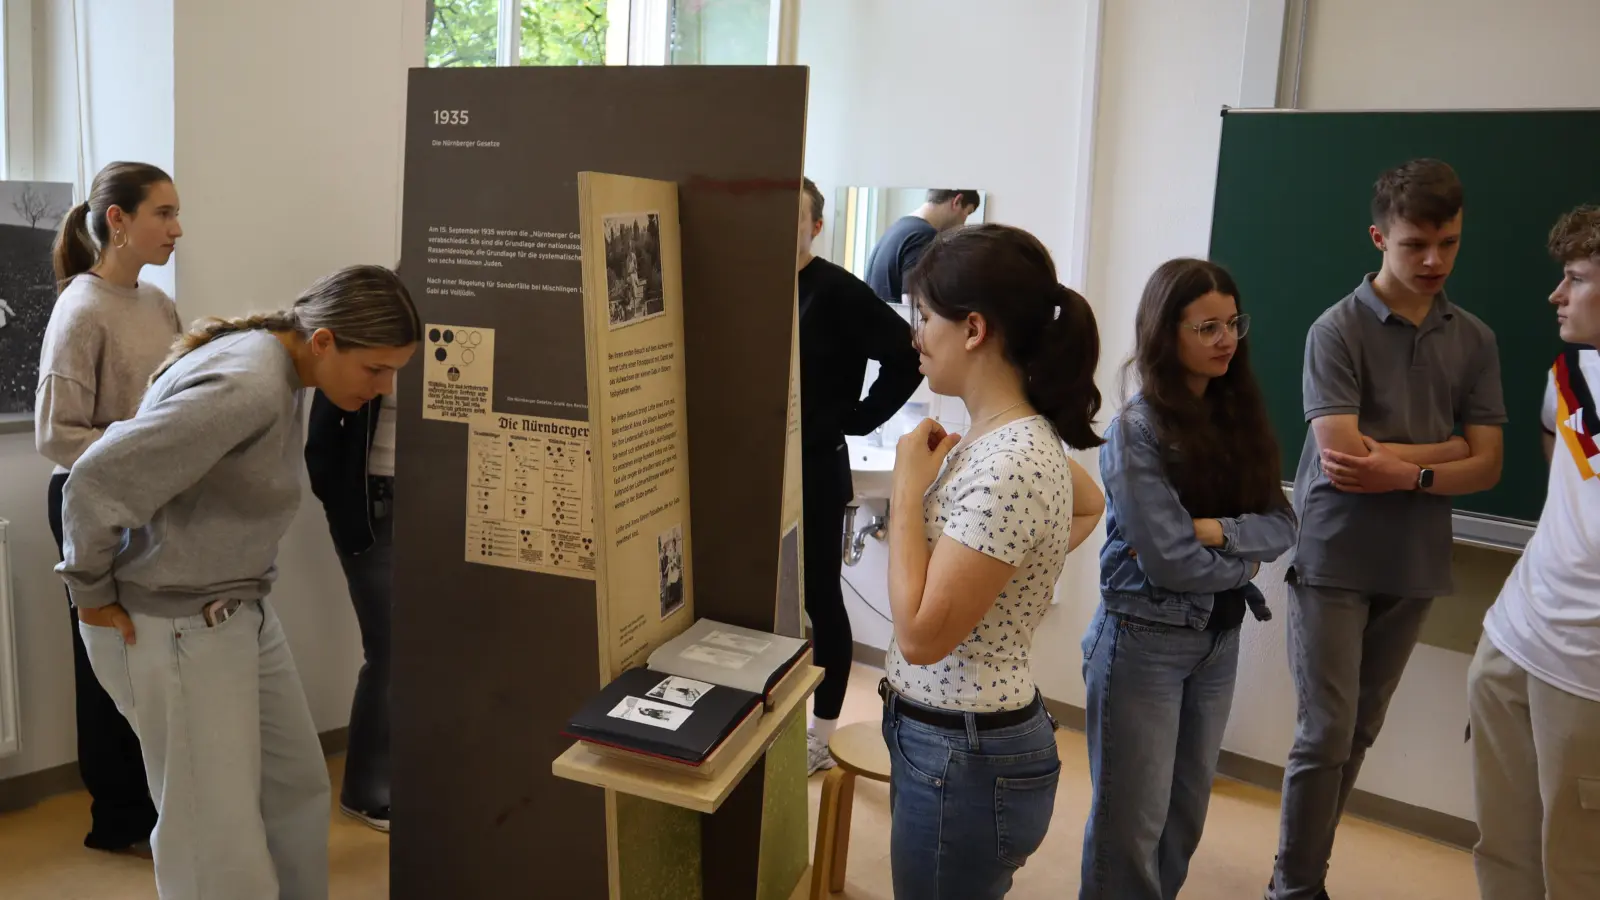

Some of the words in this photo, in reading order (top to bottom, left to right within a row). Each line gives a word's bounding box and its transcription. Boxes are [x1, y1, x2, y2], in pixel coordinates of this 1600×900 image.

[433, 110, 469, 125] 1935
[442, 140, 475, 148] Nürnberger
[505, 240, 535, 248] Grundlage
[486, 250, 516, 258] Grundlage
[458, 279, 485, 288] Regelung
[496, 282, 530, 290] Sonderfälle
[542, 284, 578, 293] Mischlingen
[499, 417, 518, 430] Die
[522, 419, 590, 438] Nürnberger
